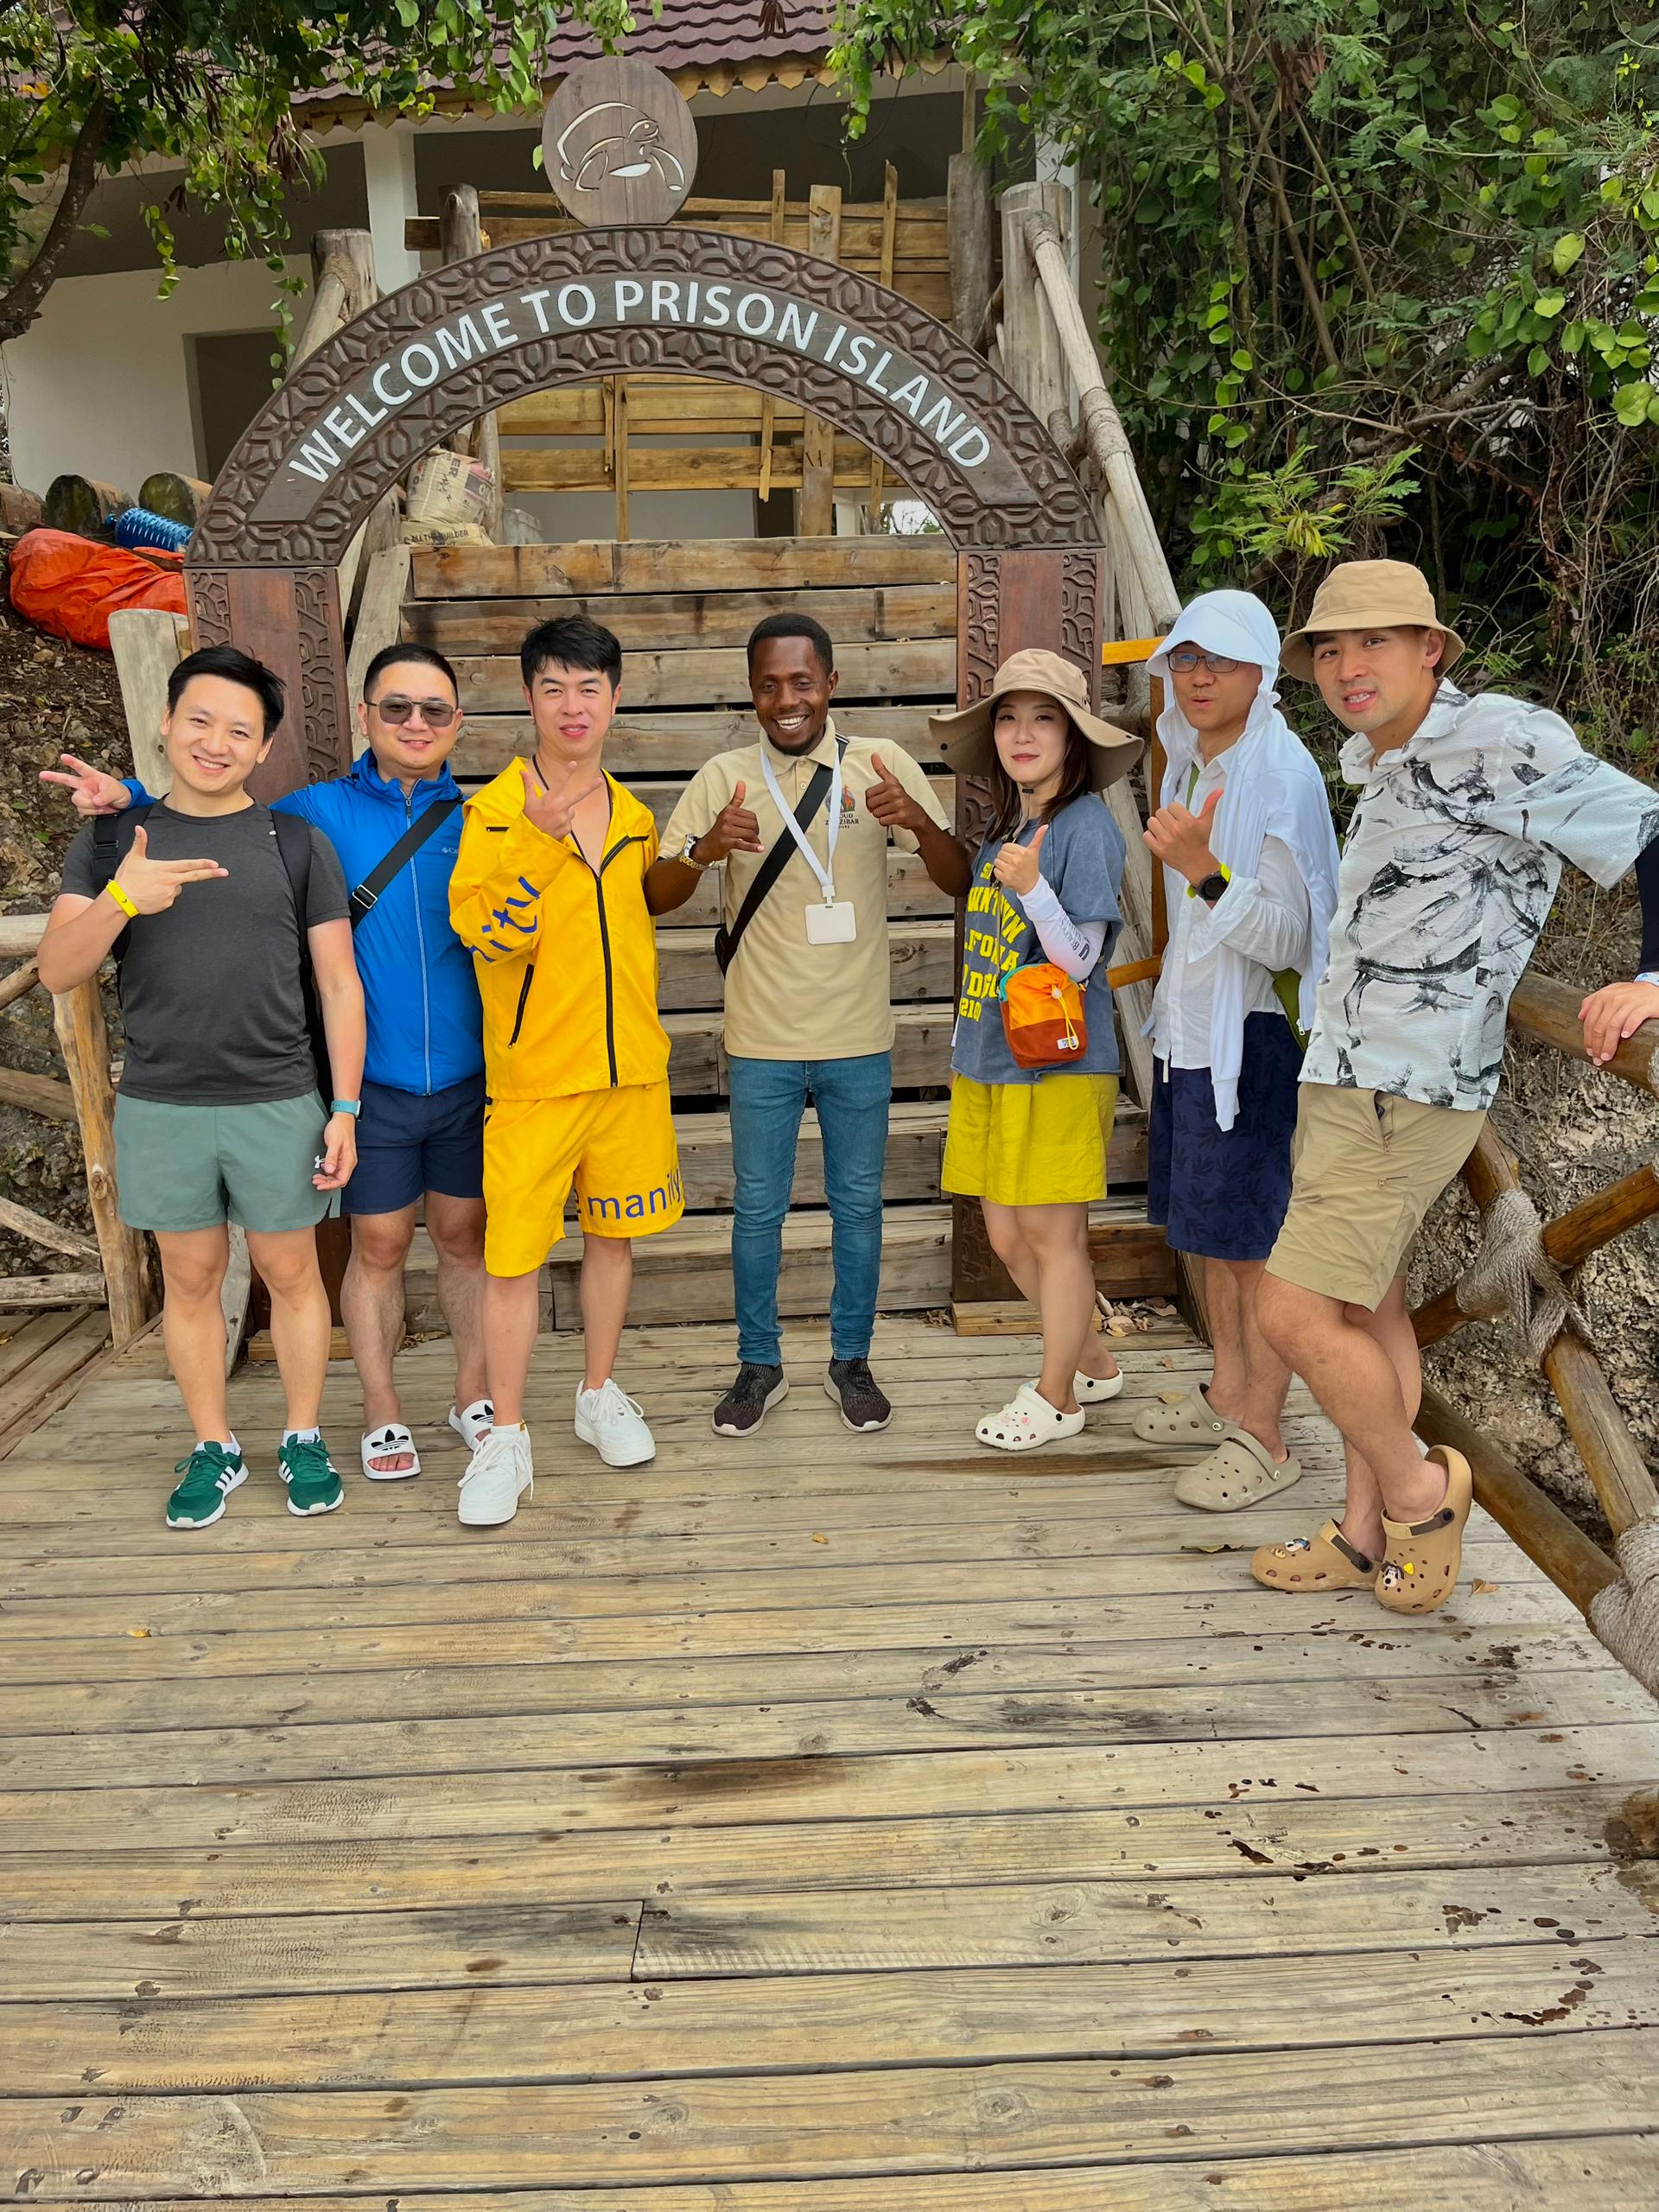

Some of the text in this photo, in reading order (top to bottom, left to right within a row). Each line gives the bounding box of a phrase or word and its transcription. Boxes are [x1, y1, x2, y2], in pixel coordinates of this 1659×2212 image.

[289, 280, 991, 483] WELCOME TO PRISON ISLAND
